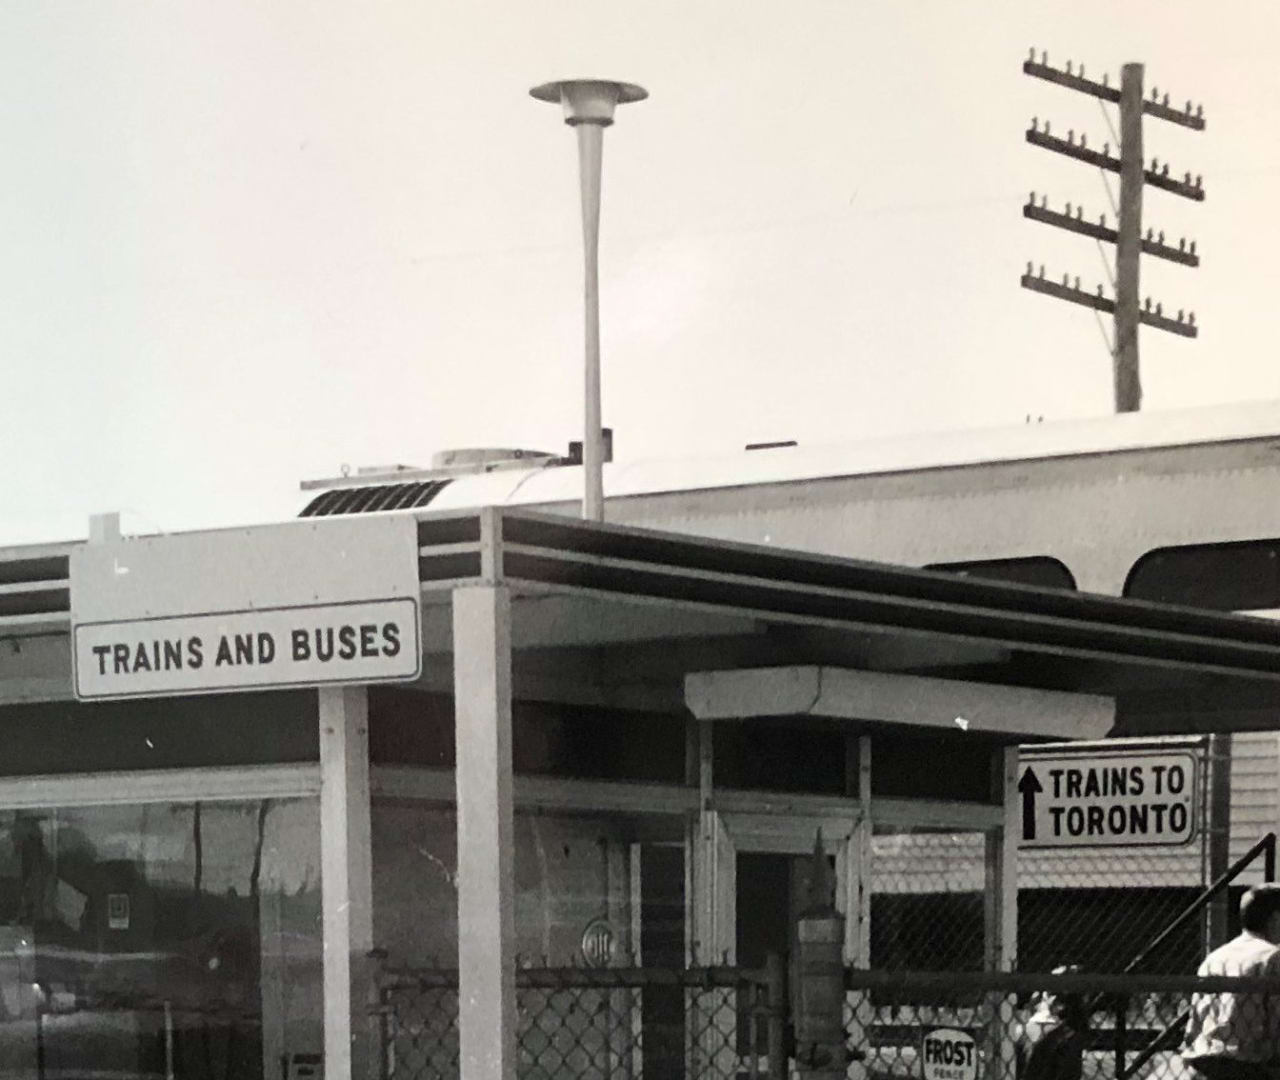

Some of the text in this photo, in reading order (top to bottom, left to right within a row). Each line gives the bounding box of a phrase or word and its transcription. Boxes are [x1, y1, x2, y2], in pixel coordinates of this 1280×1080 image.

[92, 621, 402, 676] TRAINS AND BUSES
[1048, 764, 1185, 798] TRAINS TO
[1048, 802, 1188, 836] TORONTO
[925, 1039, 975, 1067] FROST
